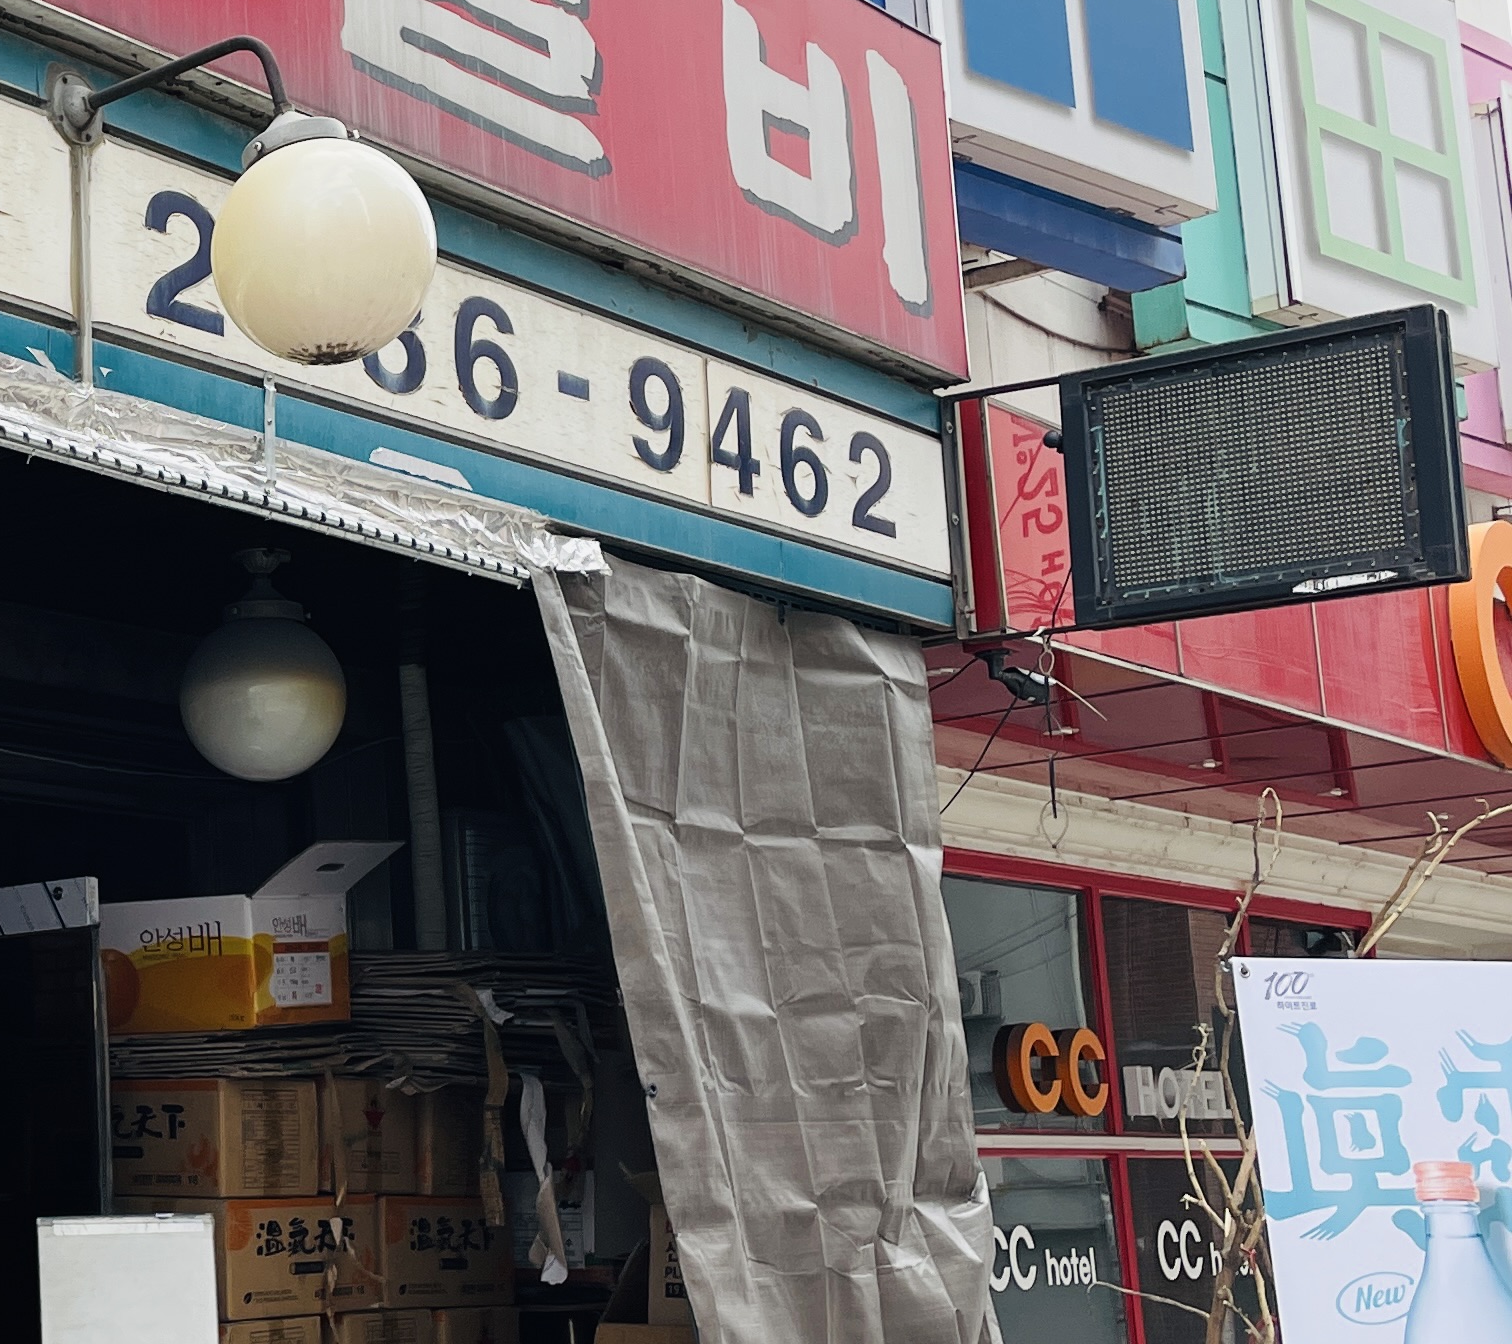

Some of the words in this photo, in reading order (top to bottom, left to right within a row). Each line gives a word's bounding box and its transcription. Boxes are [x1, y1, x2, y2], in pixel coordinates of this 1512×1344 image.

[139, 921, 223, 957] 안성배
[1018, 1022, 1109, 1117] CC
[1045, 1247, 1097, 1287] hotel
[1157, 1219, 1203, 1281] CC
[1355, 1284, 1407, 1313] New
